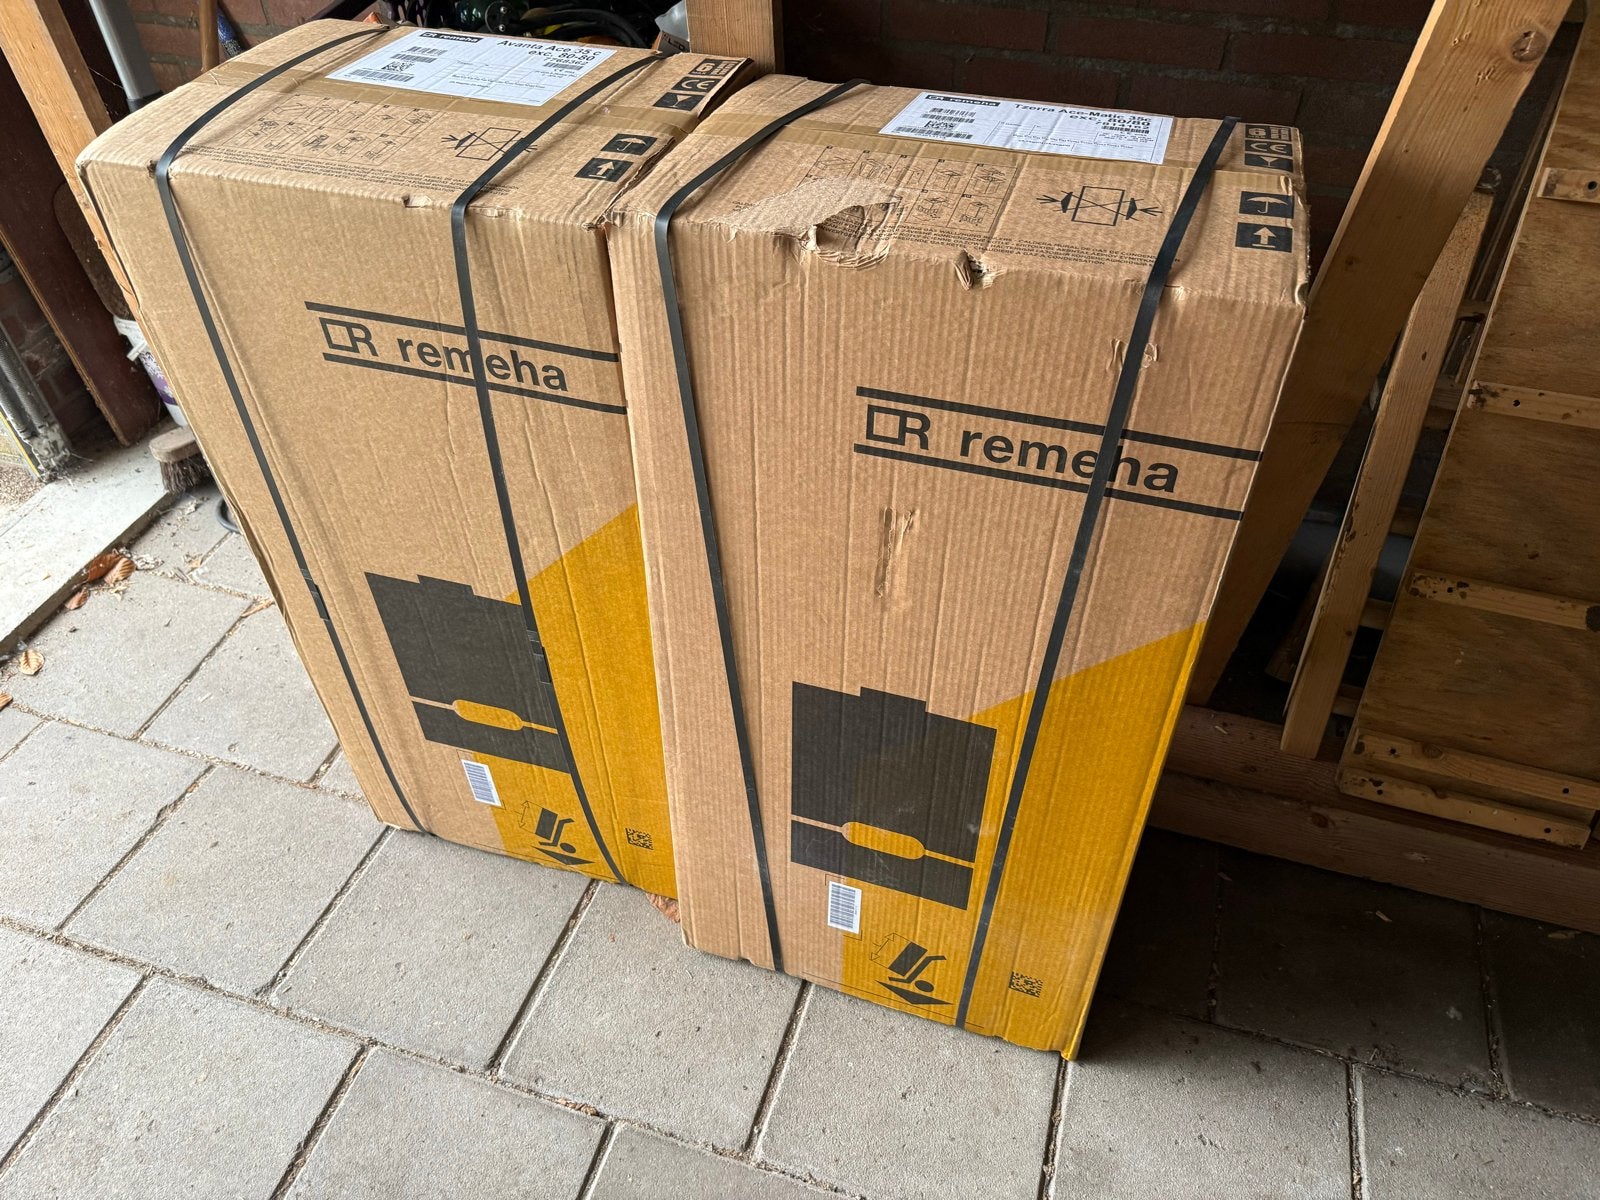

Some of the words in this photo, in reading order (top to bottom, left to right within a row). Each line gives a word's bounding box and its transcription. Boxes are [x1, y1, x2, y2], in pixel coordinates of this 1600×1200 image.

[497, 40, 544, 50] Avanta
[544, 45, 571, 53] Ace
[558, 53, 595, 61] 80-80
[1014, 103, 1055, 112] Tzerra
[1058, 108, 1124, 120] Ace-Matic
[1107, 118, 1151, 126] 80/80
[396, 337, 568, 392] remeha
[959, 429, 1180, 494] remeha
